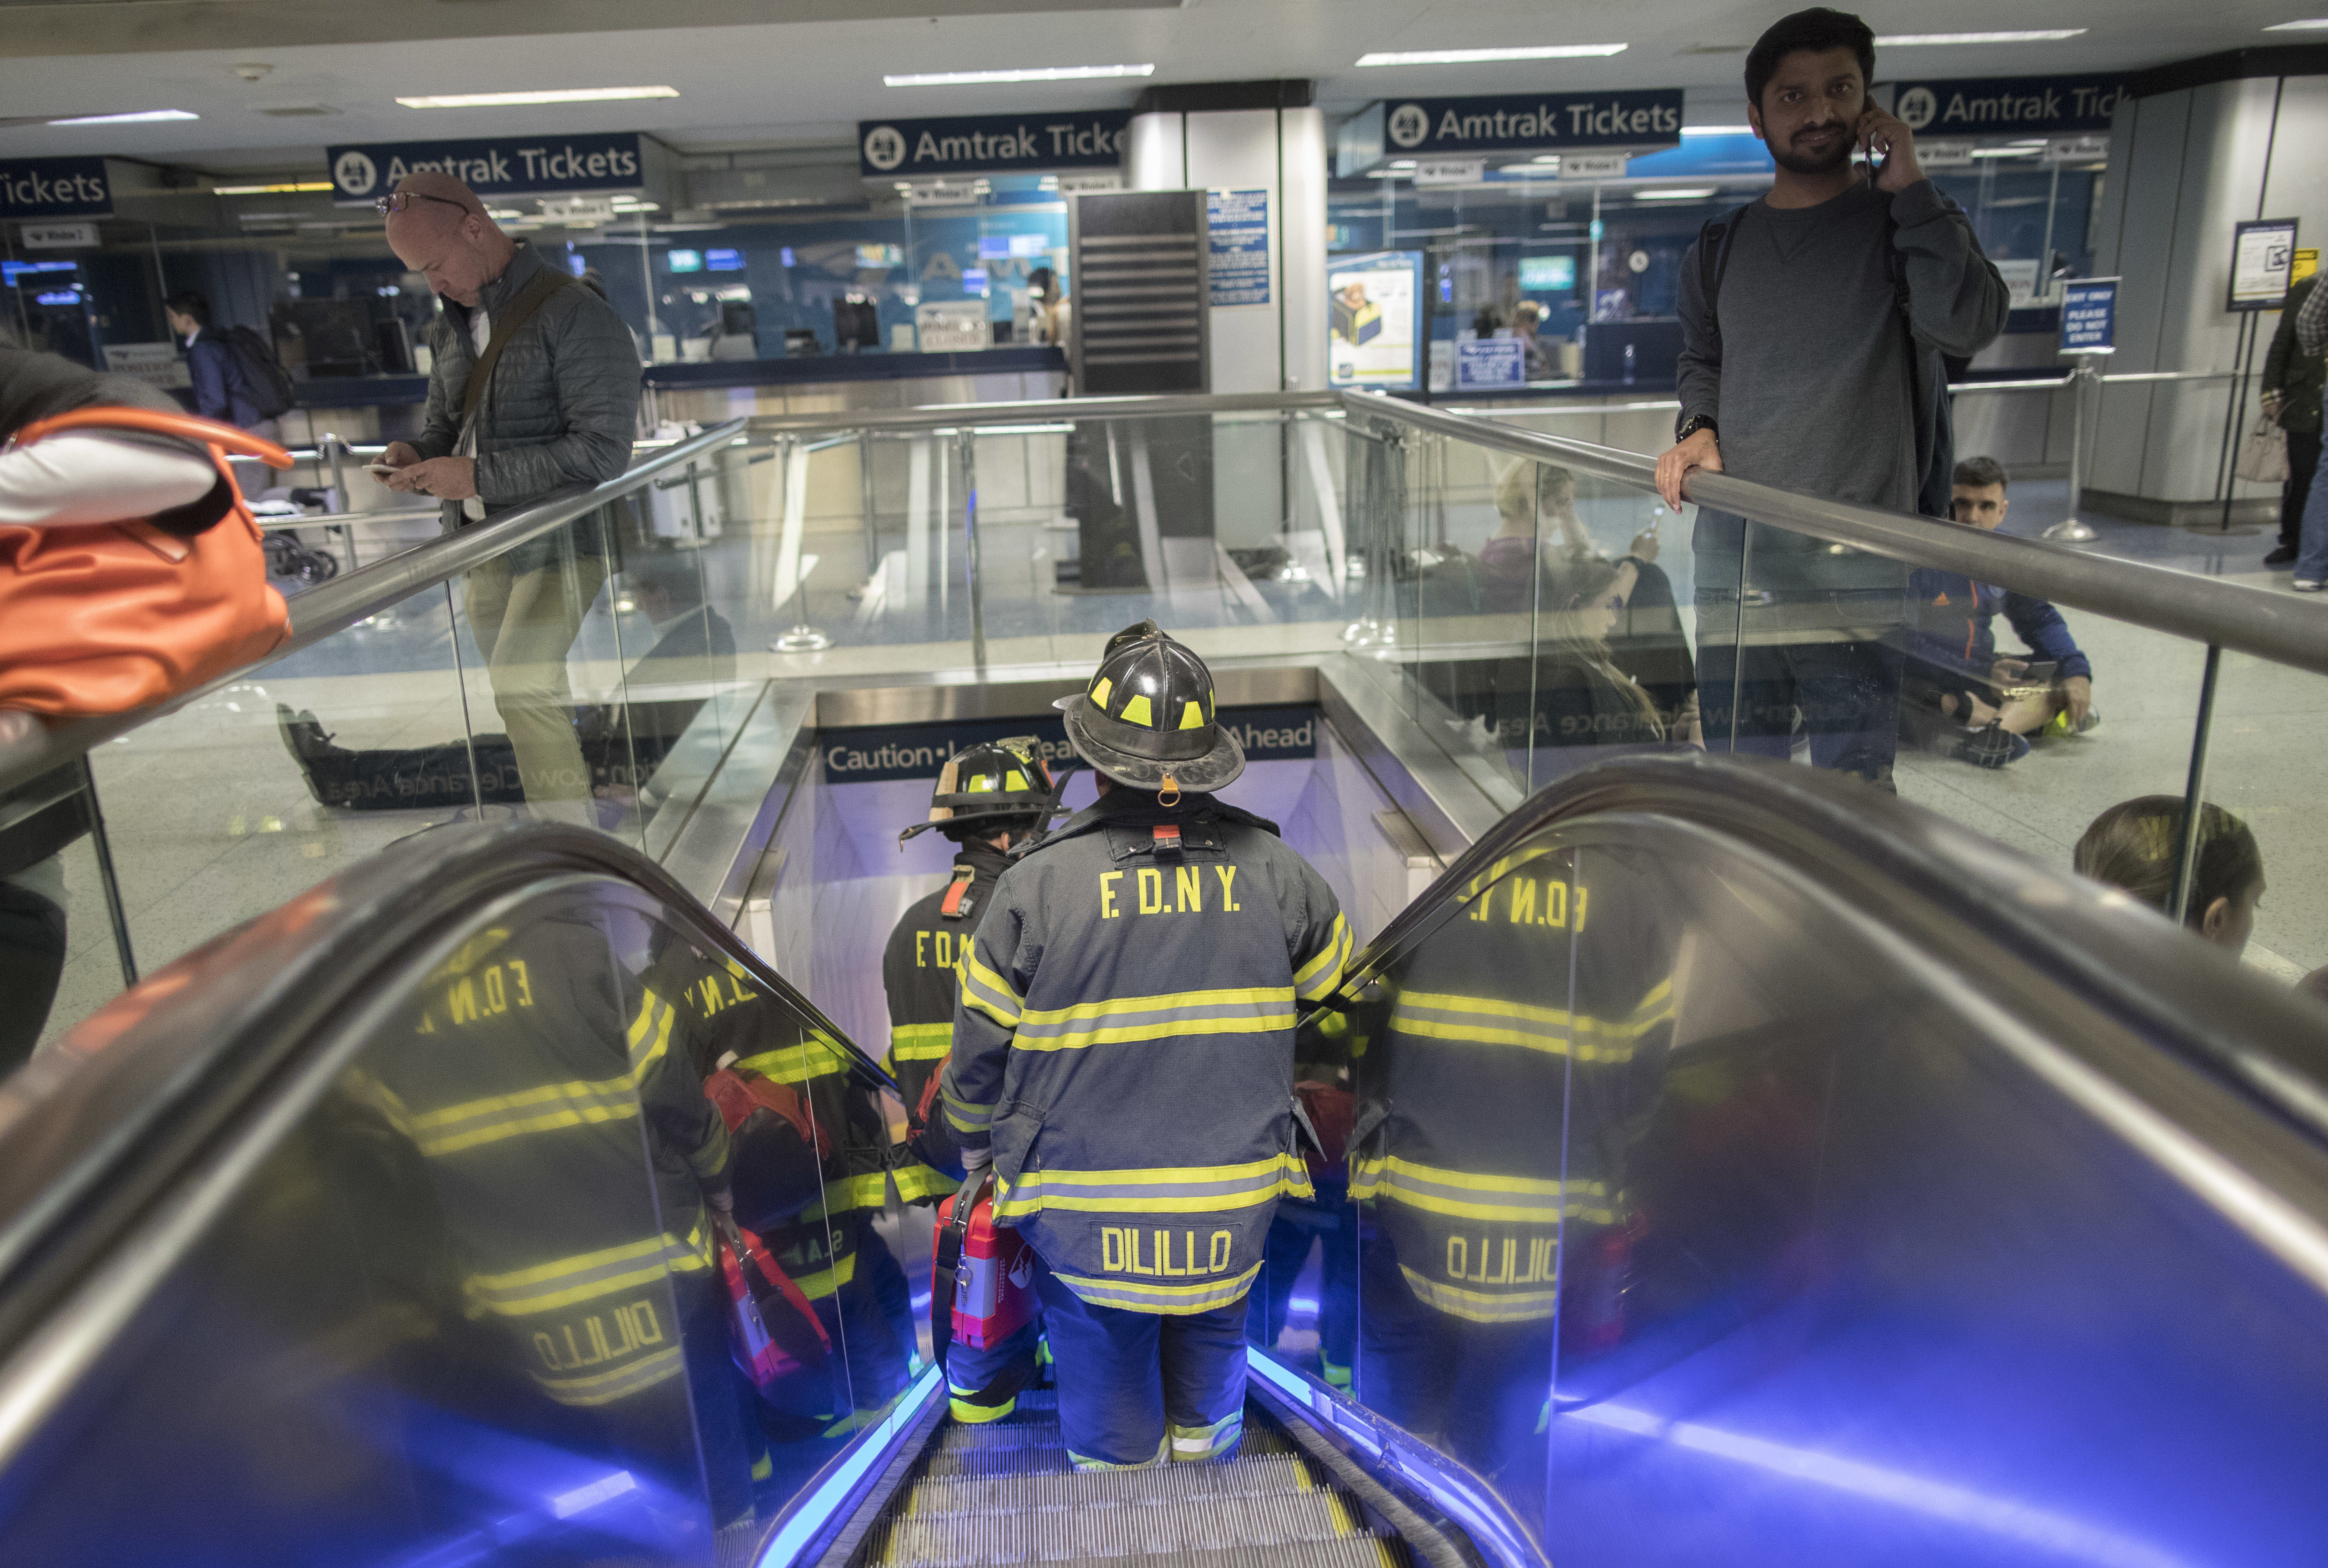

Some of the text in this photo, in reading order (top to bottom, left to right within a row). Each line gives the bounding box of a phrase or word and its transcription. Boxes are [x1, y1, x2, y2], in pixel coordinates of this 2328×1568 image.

[1436, 101, 1679, 140] Amtrak Tickets
[1942, 90, 2062, 122] Amtrak
[914, 121, 1121, 163] Amtrak Tick
[517, 145, 637, 180] Tickets
[0, 171, 105, 204] ickets
[2066, 319, 2108, 333] DO NOT
[2068, 308, 2107, 320] PLEASE
[2068, 331, 2103, 344] ENTER
[828, 743, 933, 771] Caution
[1101, 1227, 1232, 1276] DILILLO
